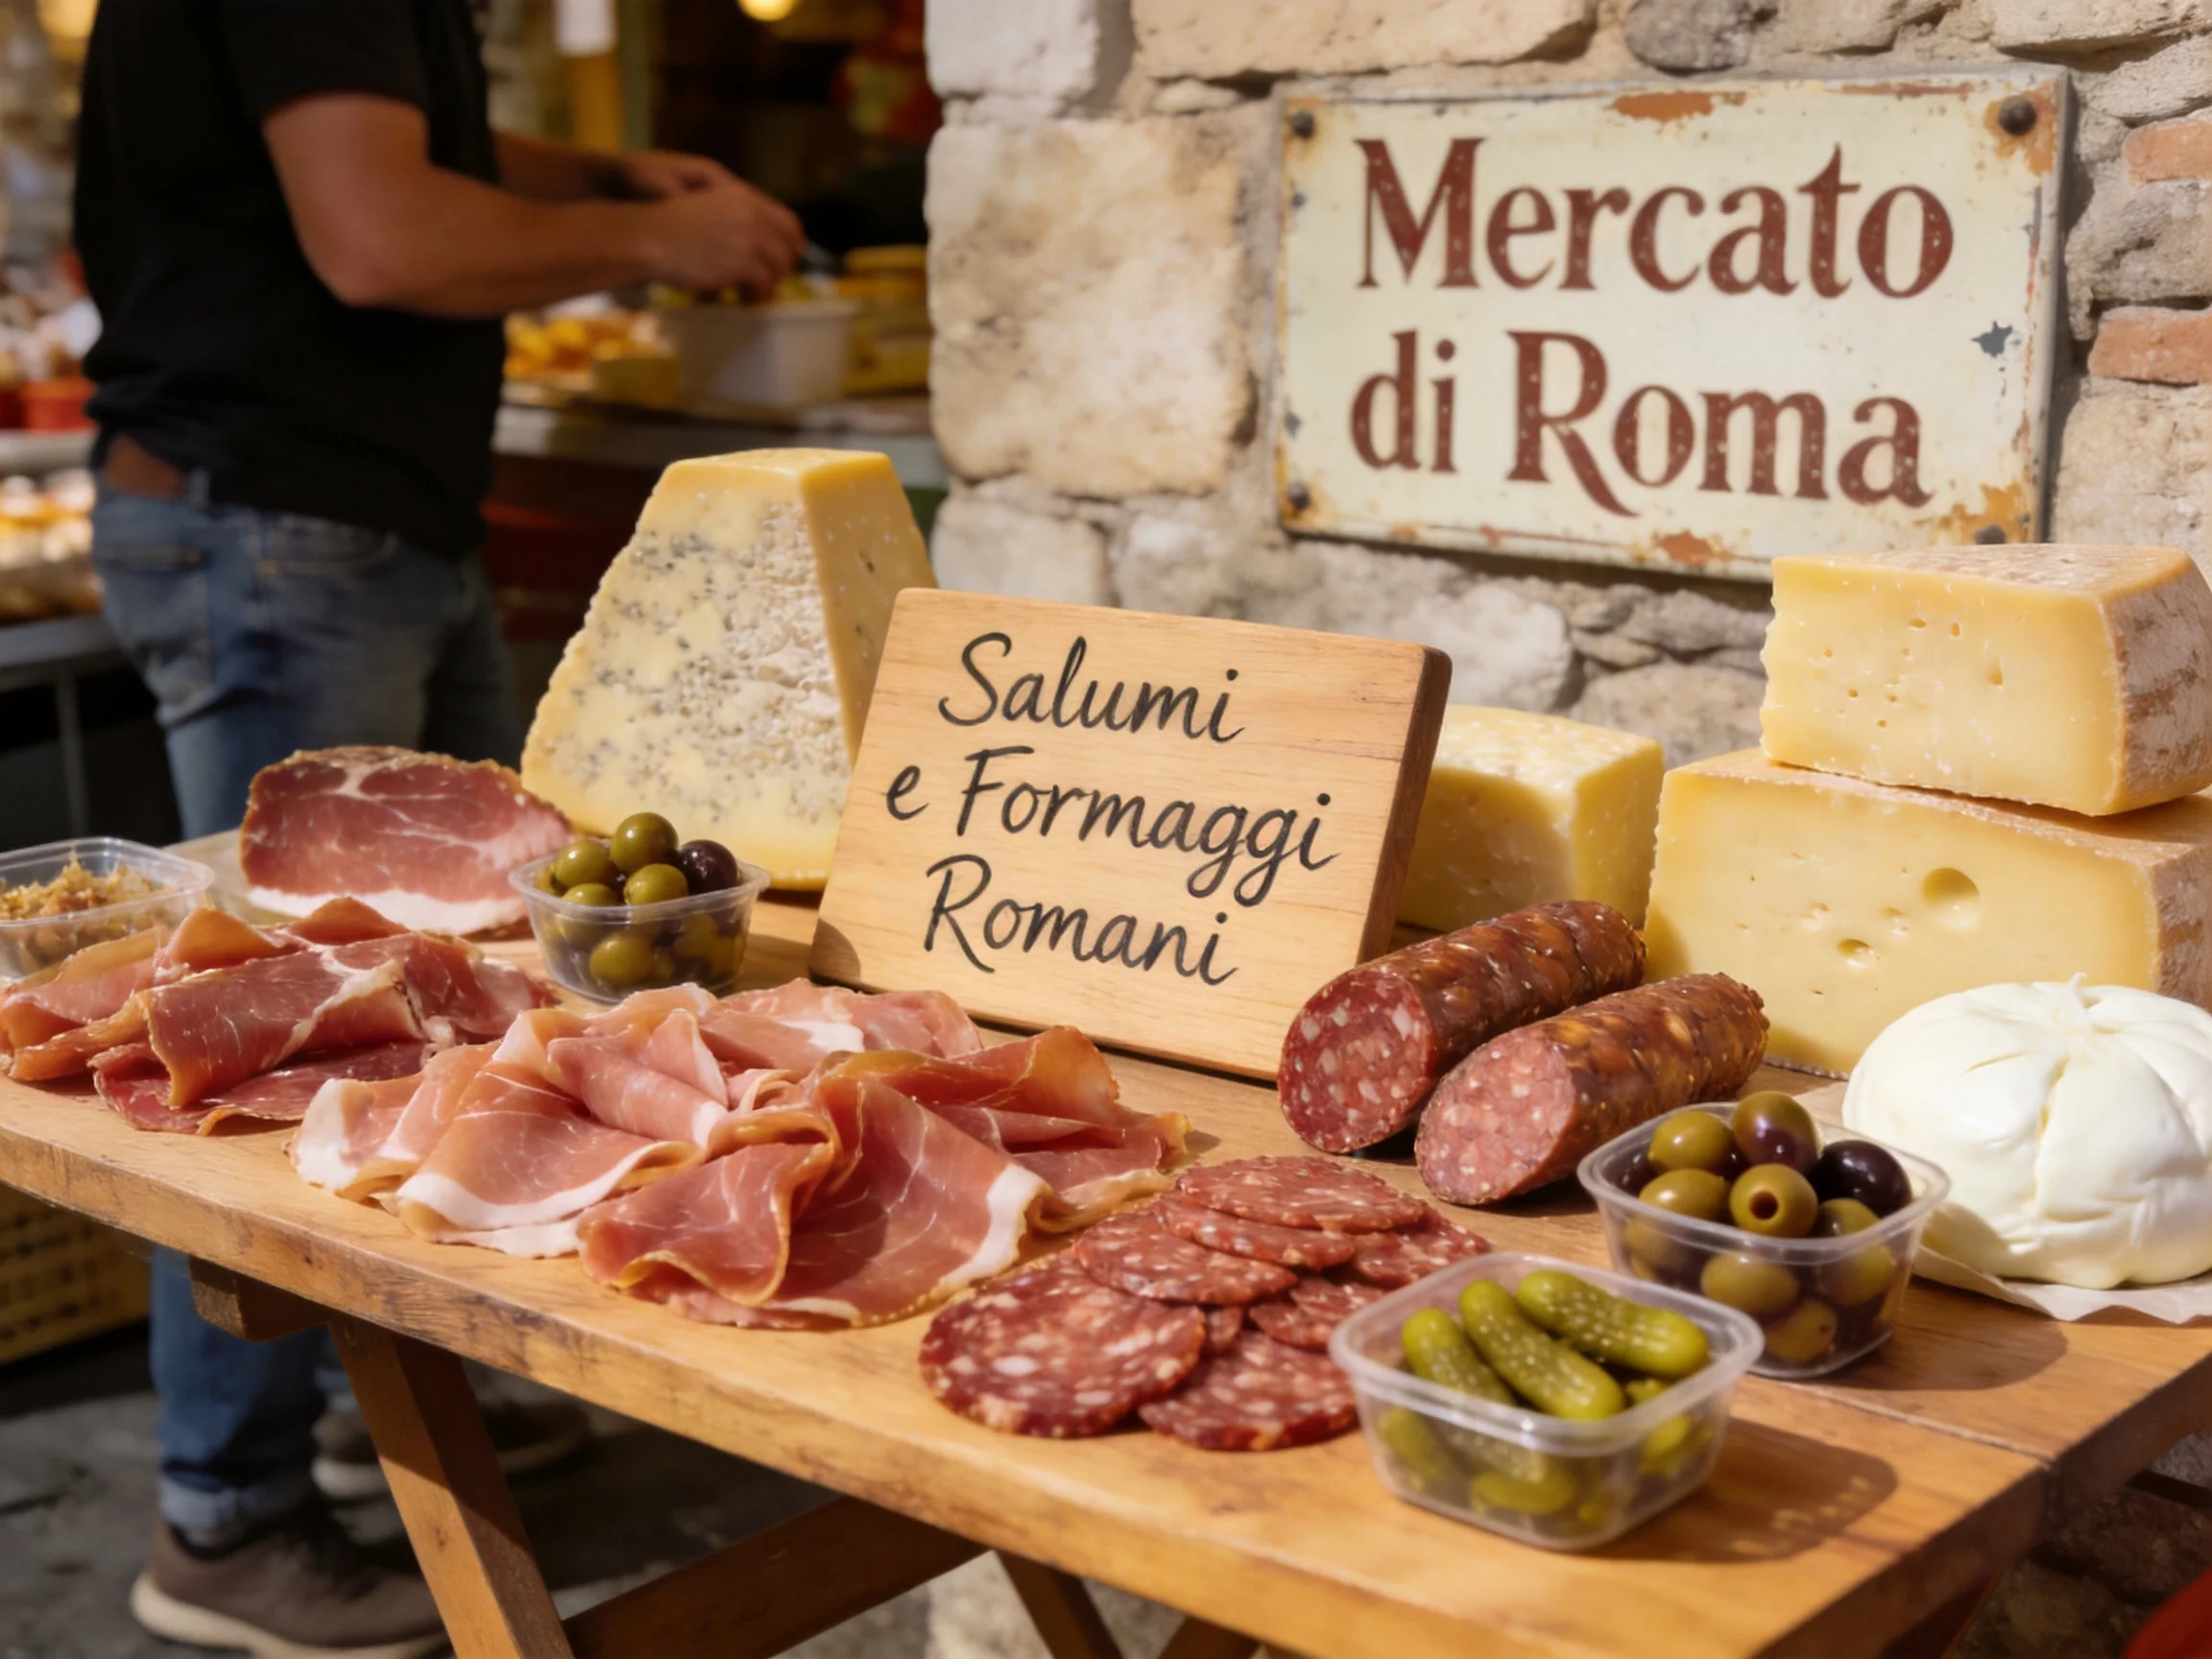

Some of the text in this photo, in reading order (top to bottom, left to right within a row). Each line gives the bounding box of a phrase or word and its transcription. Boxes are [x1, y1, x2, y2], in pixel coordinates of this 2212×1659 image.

[1356, 136, 1954, 299] Mercato
[1350, 330, 1935, 518] di Roma
[938, 631, 1246, 743] Salumi
[886, 745, 1339, 907] e Formaggi
[924, 854, 1238, 986] Romani
